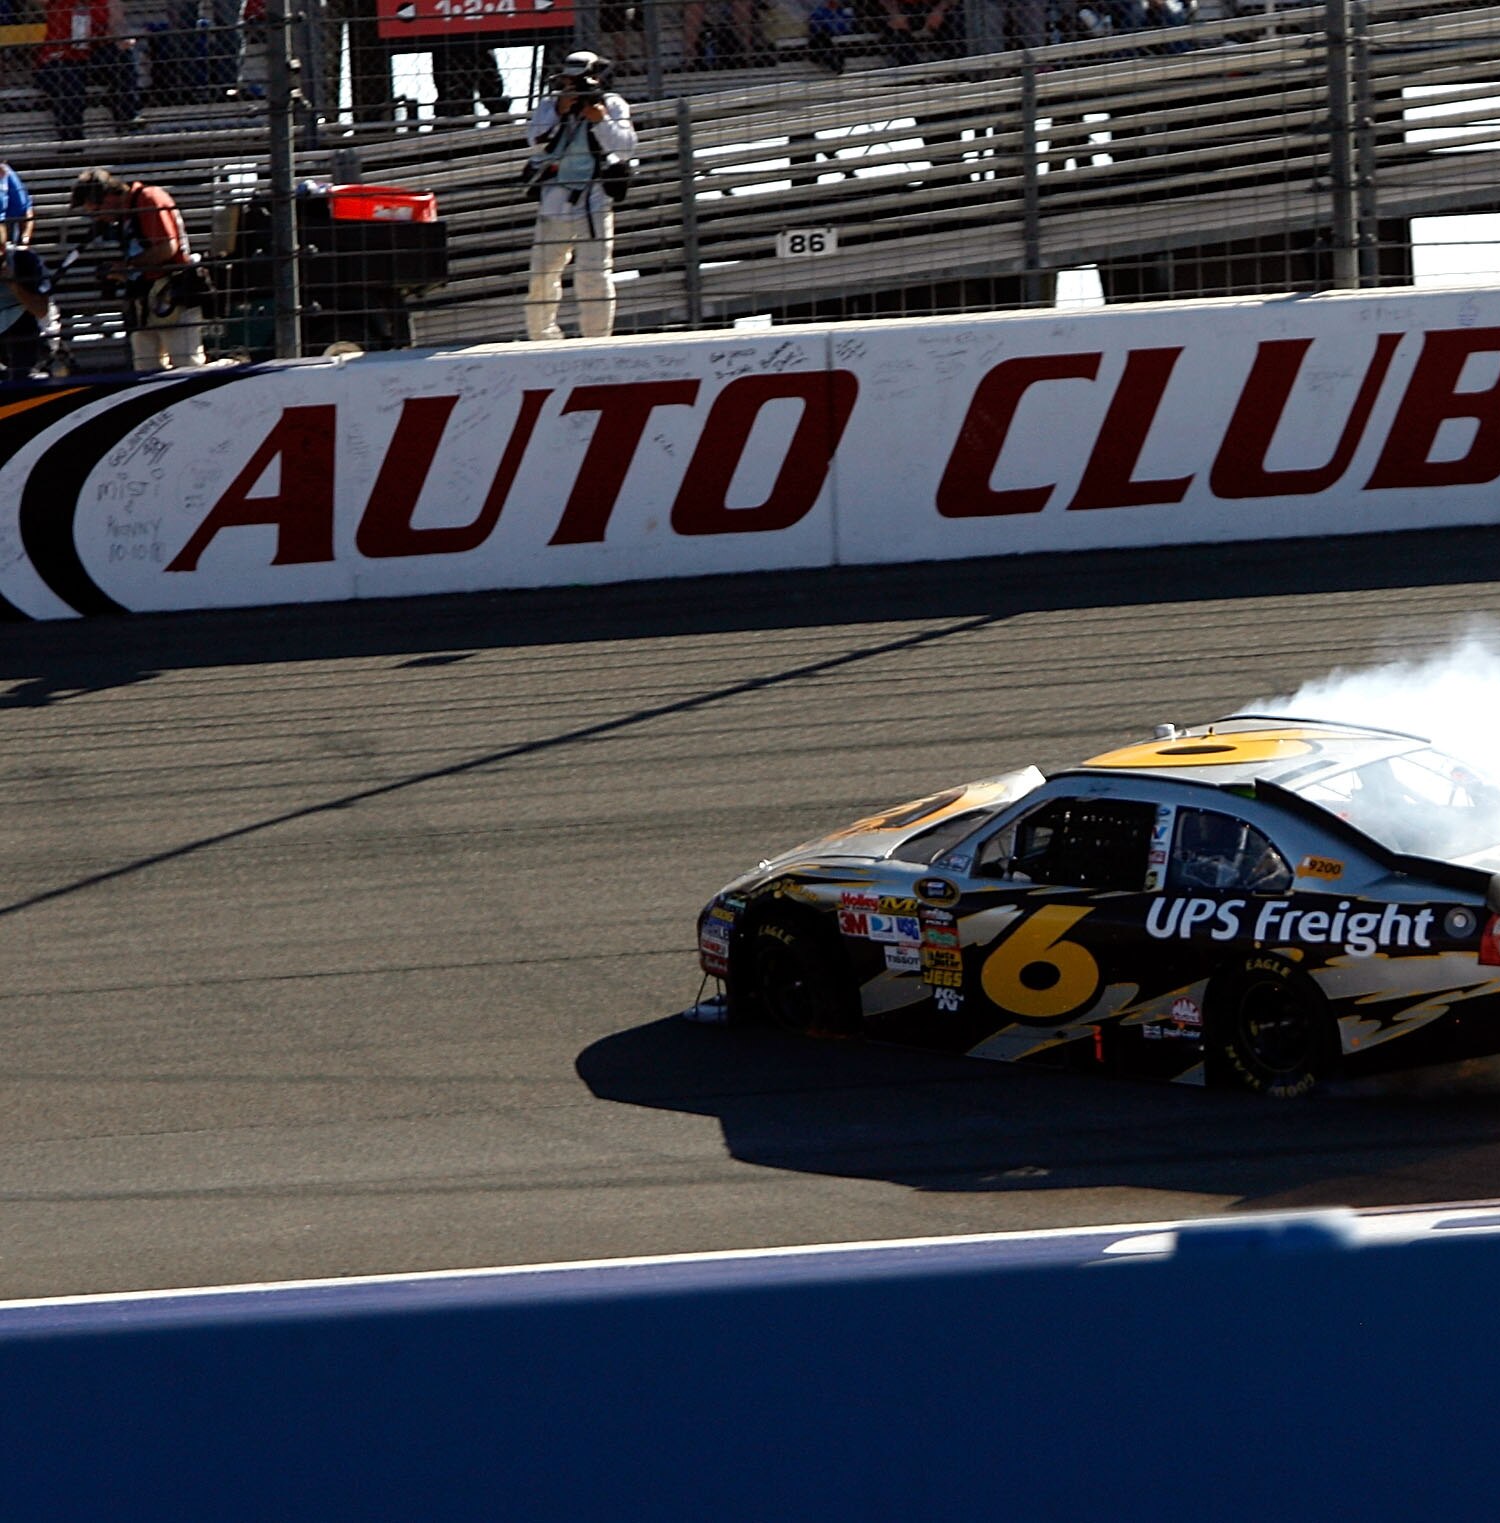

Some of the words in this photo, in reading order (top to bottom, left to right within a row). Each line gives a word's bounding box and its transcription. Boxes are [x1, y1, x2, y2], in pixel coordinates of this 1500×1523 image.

[790, 233, 825, 253] 86
[165, 368, 858, 573] AUTO
[1310, 858, 1342, 875] 9200
[842, 892, 879, 911] Holley
[840, 912, 869, 934] 3M
[1145, 897, 1246, 941] UPS
[1254, 902, 1434, 957] Freight
[886, 955, 920, 966] TISSOT
[981, 904, 1099, 1017] 6
[1245, 958, 1292, 978] EAGLE
[923, 968, 962, 987] JEGS
